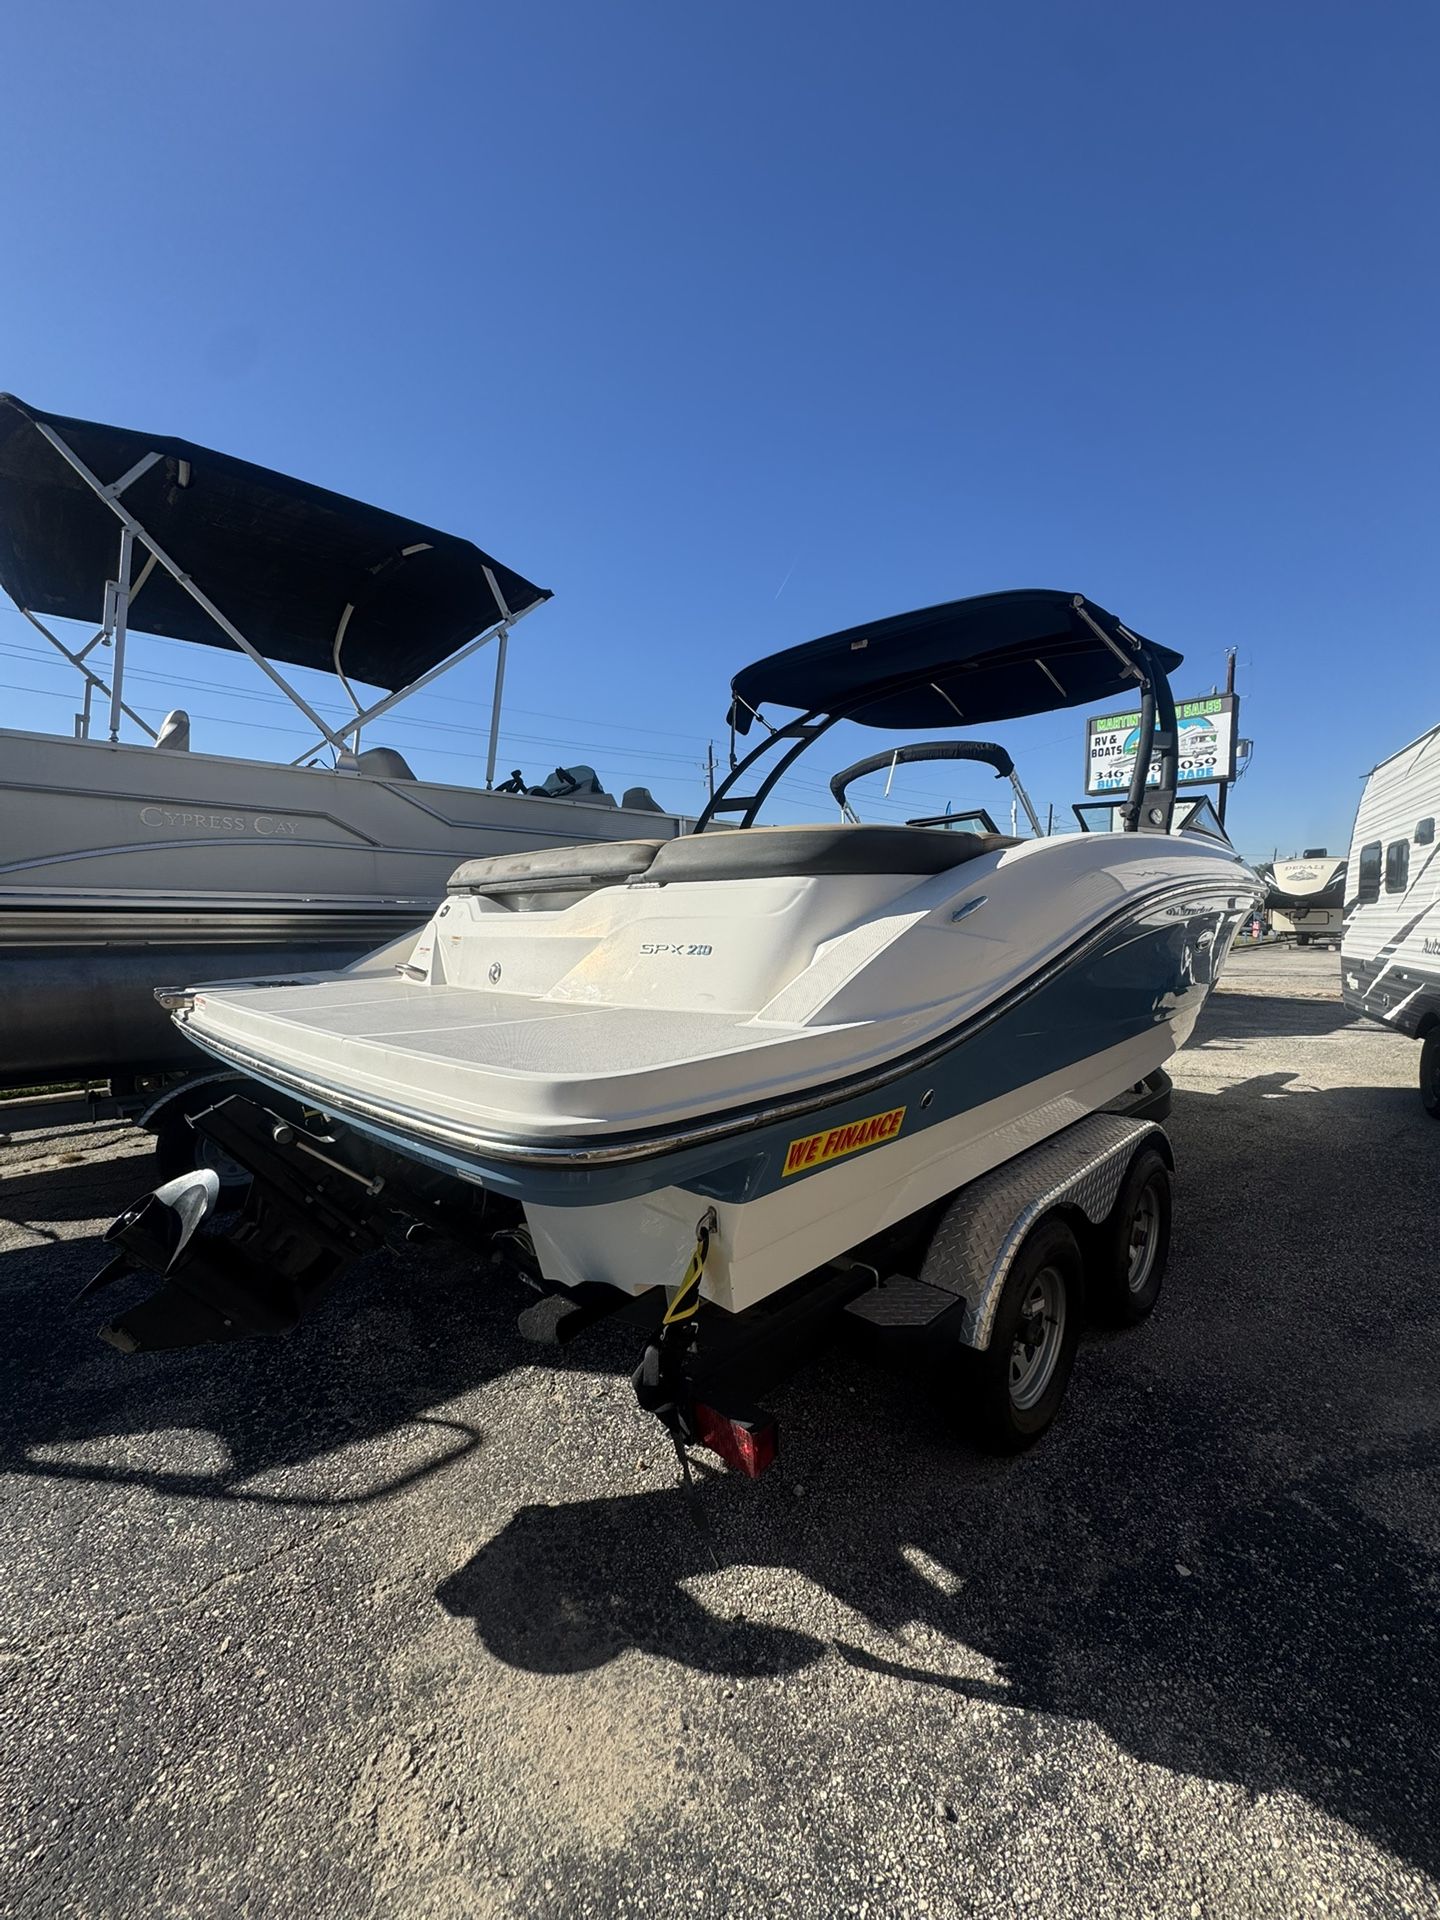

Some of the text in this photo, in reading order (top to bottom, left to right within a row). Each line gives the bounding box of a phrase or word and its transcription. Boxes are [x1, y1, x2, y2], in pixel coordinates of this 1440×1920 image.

[1184, 698, 1222, 718] SALES
[1095, 734, 1117, 747] RV &
[1091, 745, 1122, 758] BOATS
[139, 806, 299, 835] CYPRESS CAY
[640, 944, 684, 955] SPX
[788, 1110, 904, 1169] WE FINANCE
